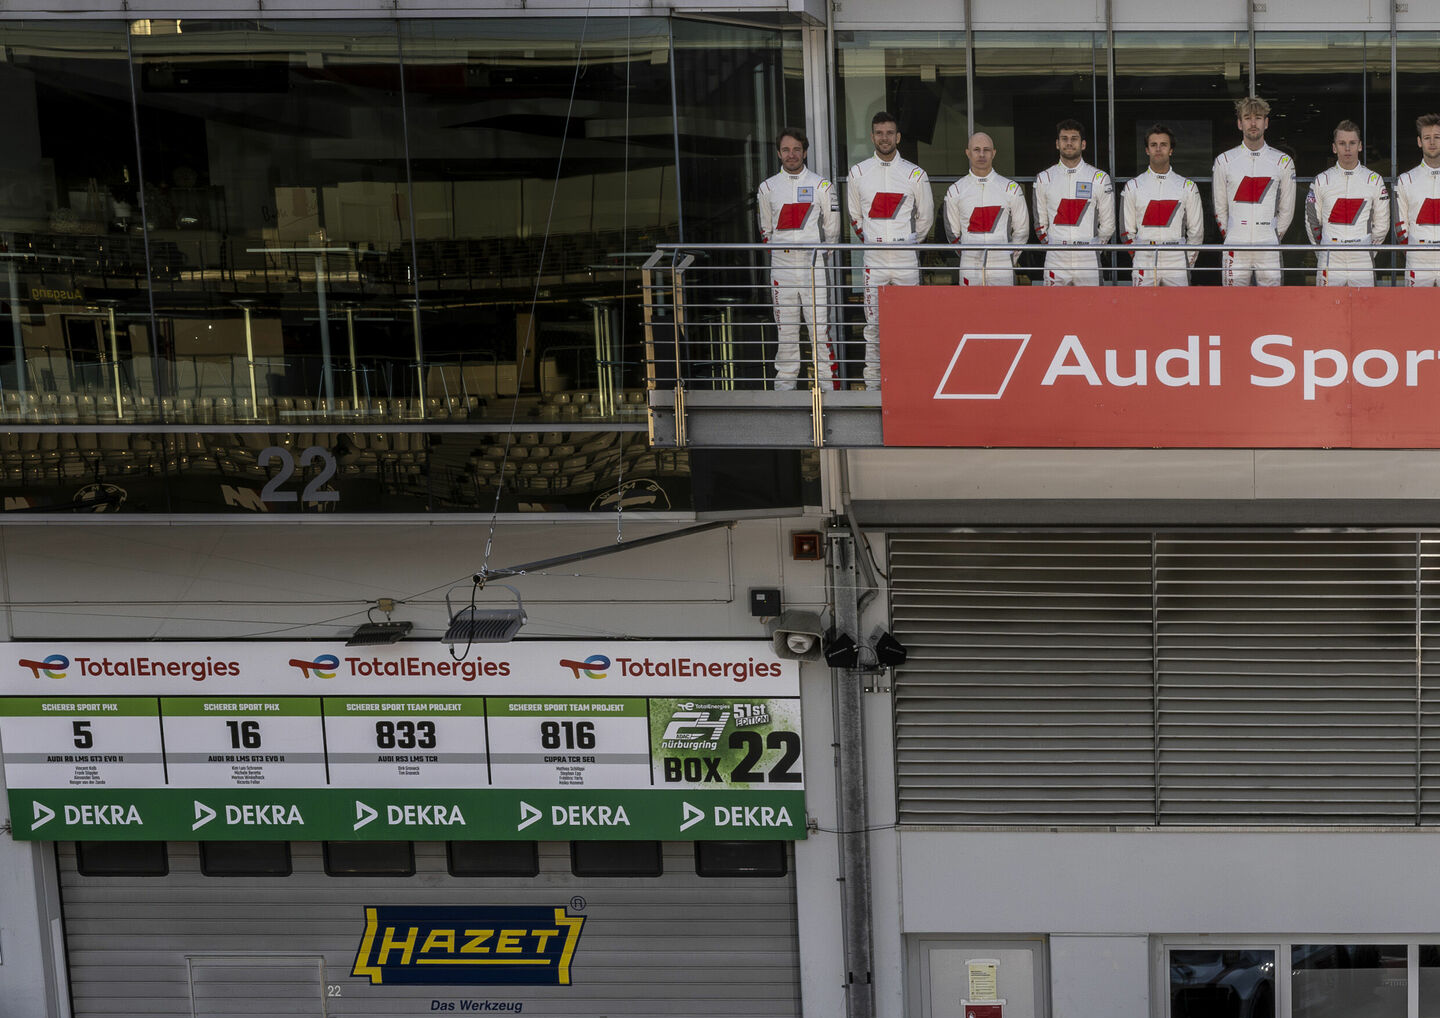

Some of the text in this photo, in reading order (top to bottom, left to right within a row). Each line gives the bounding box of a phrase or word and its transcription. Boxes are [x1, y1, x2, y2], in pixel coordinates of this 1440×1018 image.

[1041, 334, 1222, 387] Audi
[258, 446, 341, 502] 22
[75, 657, 240, 681] TotalEnergies
[345, 657, 510, 681] TotalEnergies
[616, 657, 782, 682] TotalEnergies
[509, 704, 624, 712] SCHERER SPORT TEAM PROJEKT
[733, 703, 766, 718] 51st
[72, 721, 93, 748] 5
[226, 721, 261, 748] 16
[376, 721, 436, 748] 833
[541, 722, 595, 749] 816
[662, 740, 717, 750] nürburgring
[664, 731, 802, 782] BOX 22
[64, 805, 143, 825] DEKRA
[226, 805, 304, 825] DEKRA
[388, 806, 466, 825] DEKRA
[552, 806, 630, 826] DEKRA
[714, 806, 792, 826] DEKRA
[377, 927, 559, 965] HAZET
[327, 986, 342, 997] 22
[431, 1000, 522, 1014] Das Werkzeug
